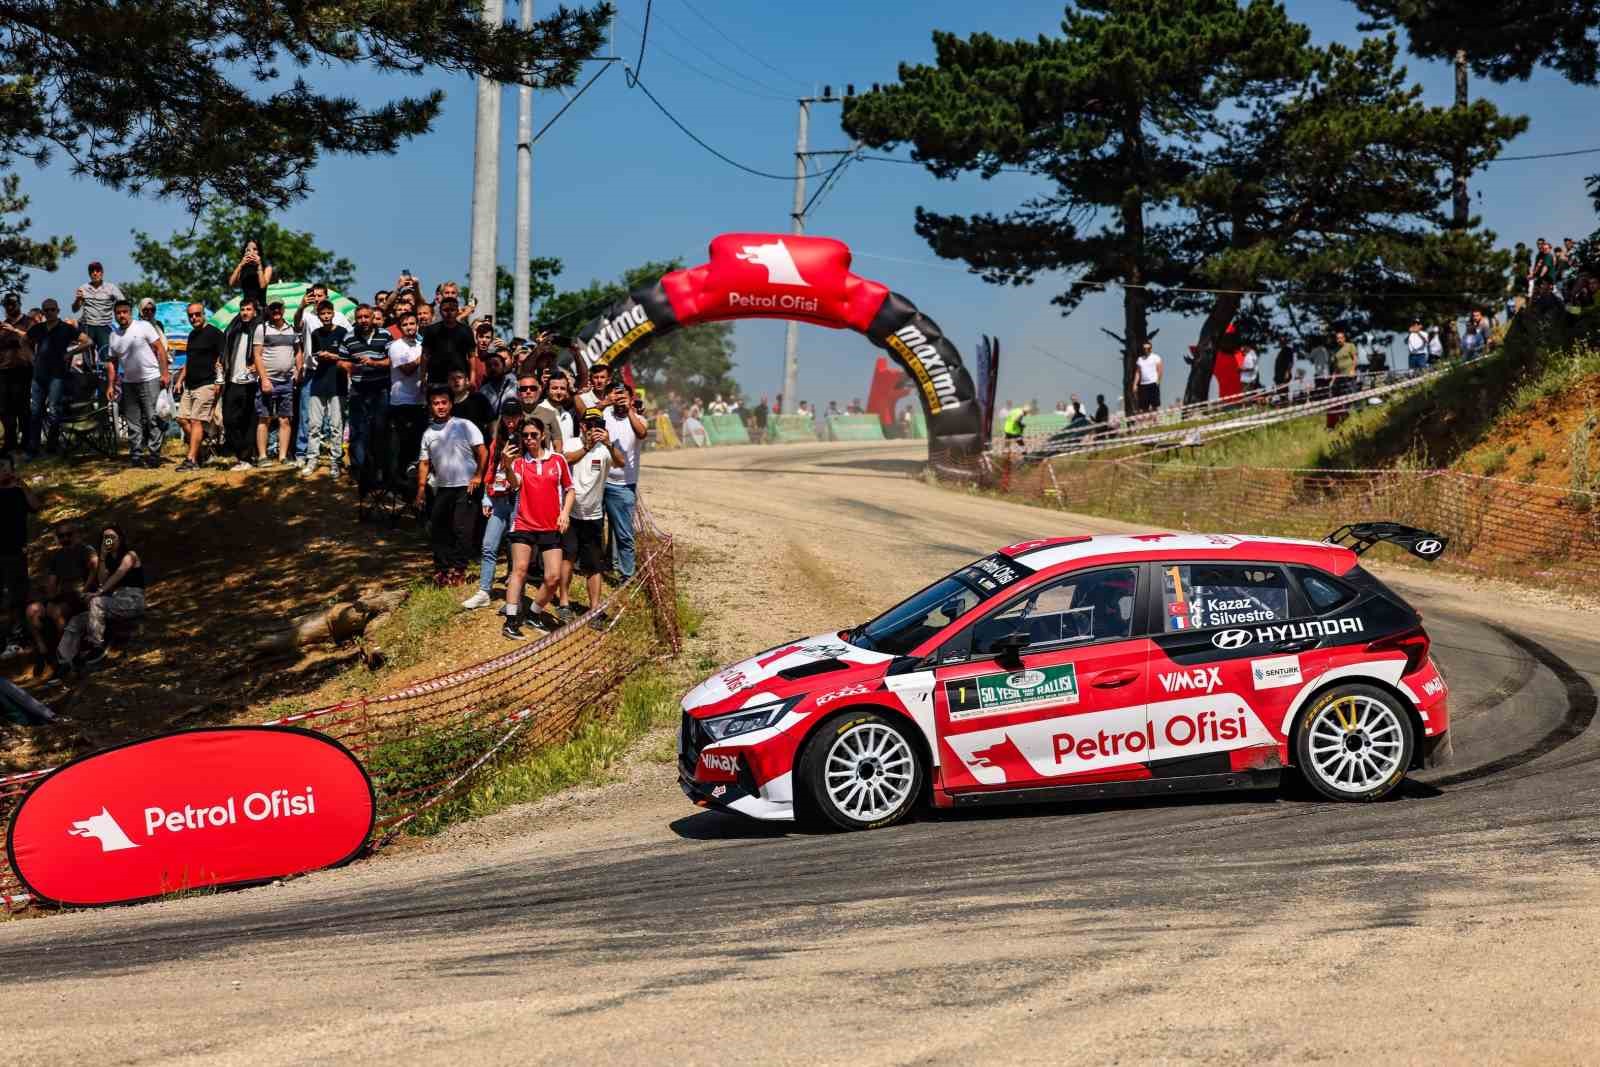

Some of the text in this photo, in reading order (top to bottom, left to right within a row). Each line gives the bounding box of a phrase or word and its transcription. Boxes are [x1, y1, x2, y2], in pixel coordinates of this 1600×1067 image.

[729, 292, 819, 312] Petrol Ofisi
[895, 325, 960, 410] maxima
[1189, 598, 1252, 614] K. Kazaz
[1209, 610, 1275, 626] Silvestre
[1257, 617, 1364, 643] HYUNDAI
[1052, 707, 1247, 765] Petrol Ofisi
[144, 786, 316, 837] Petrol Ofisi
